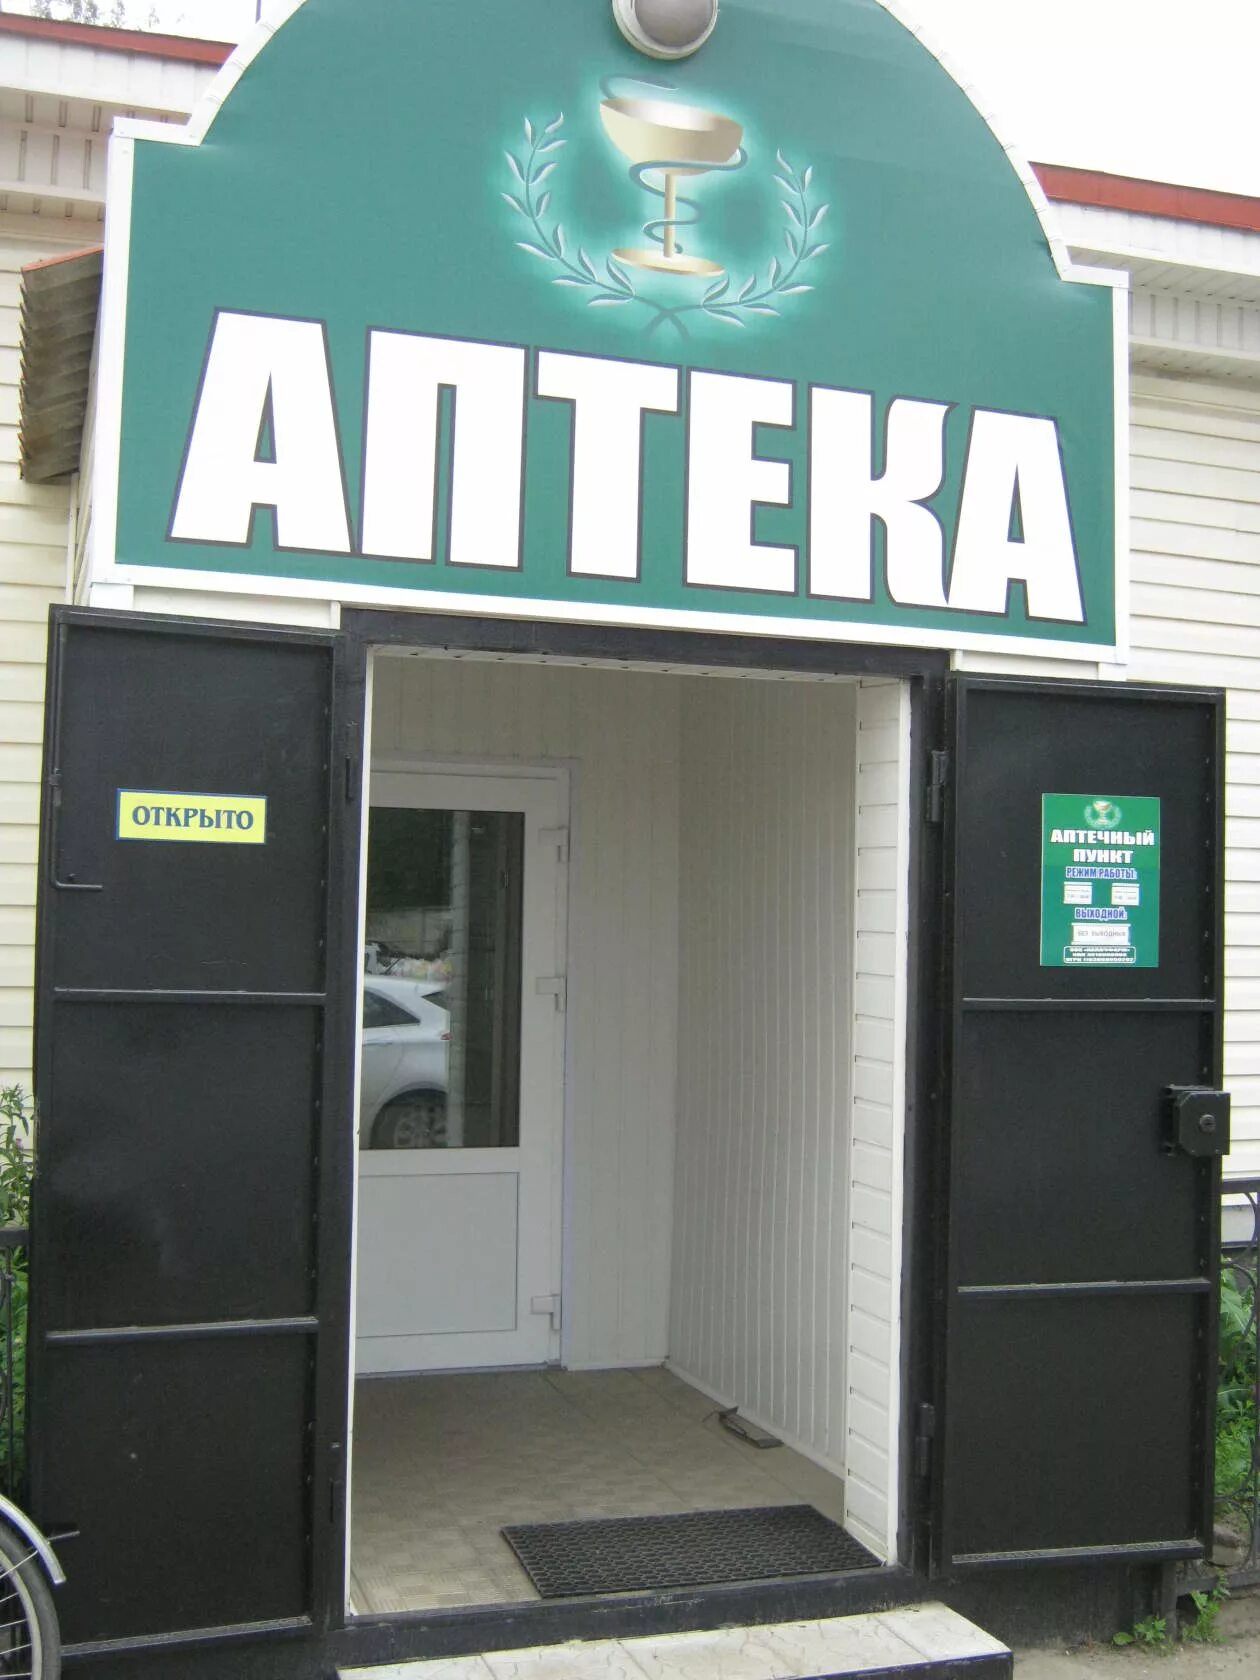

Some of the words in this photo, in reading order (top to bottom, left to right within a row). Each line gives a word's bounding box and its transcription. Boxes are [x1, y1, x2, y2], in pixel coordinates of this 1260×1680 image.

[165, 307, 1087, 625] АПТЕКА
[131, 804, 254, 831] ОТКРЫТО
[1050, 829, 1155, 846] АПТЕЧНЫЙ
[1073, 848, 1133, 863] ПУНКТ
[1066, 867, 1098, 879] РЕЖИМ
